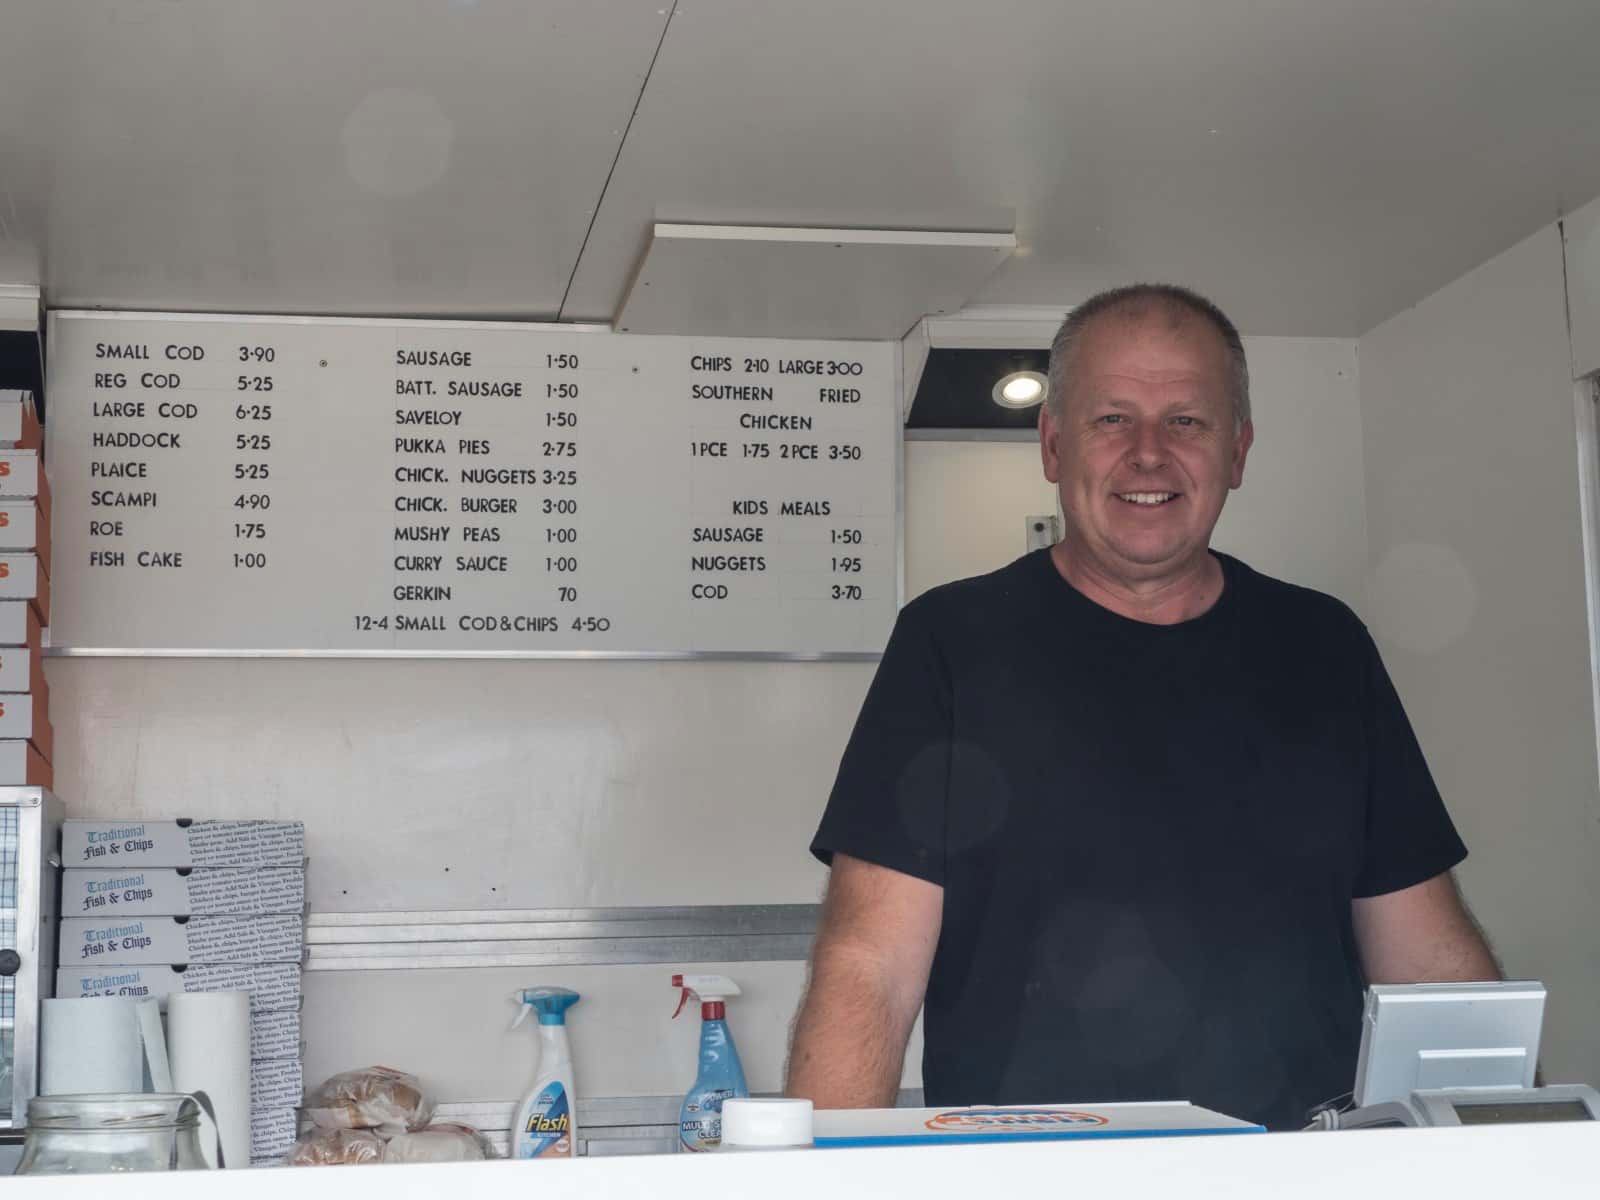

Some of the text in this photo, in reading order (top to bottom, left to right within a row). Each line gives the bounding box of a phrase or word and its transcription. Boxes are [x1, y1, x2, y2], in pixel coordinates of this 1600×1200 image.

[96, 343, 150, 360] SMALL
[165, 345, 205, 361] COD
[396, 350, 472, 367] SAUSAGE
[690, 356, 733, 372] CHIPS
[779, 360, 825, 376] LARGE
[95, 373, 128, 389] REG
[141, 373, 181, 389] COD
[396, 379, 437, 396] BATT.
[448, 381, 523, 398] SAUSAGE
[692, 384, 862, 404] SOUTHERN FRIED
[93, 402, 146, 418] LARGE
[158, 402, 199, 420] COD
[396, 410, 463, 427] SAVELOY
[740, 413, 813, 431] CHICKEN
[93, 432, 181, 449] HADDOCK
[395, 438, 447, 454] PUKKA
[459, 440, 491, 456] PIES
[691, 442, 697, 457] 1
[700, 442, 728, 458] PCE
[780, 444, 790, 459] 2
[792, 444, 819, 460] PCE
[91, 462, 148, 479] PLAICE
[395, 467, 449, 484] CHICK.
[461, 469, 537, 485] NUGGETS
[91, 491, 157, 508] SCAMPI
[395, 496, 448, 513] CHICK.
[461, 497, 518, 514] BURGER
[733, 500, 831, 517] KIDS MEALS
[90, 521, 124, 537] ROE
[394, 526, 451, 543] MUSHY
[464, 527, 501, 543] PEAS
[693, 528, 764, 543] SAUSAGE
[90, 552, 125, 567] FISH
[137, 551, 183, 568] CAKE
[394, 556, 443, 572] CURRY
[456, 556, 508, 572] SAUCE
[692, 556, 767, 572] NUGGETS
[393, 586, 578, 603] GERKIN 70
[692, 584, 729, 600] COD
[355, 616, 389, 631] 12-4
[395, 615, 447, 632] SMALL
[86, 824, 145, 843] Traditional
[83, 839, 153, 860] Fish & Chips
[86, 874, 144, 893] Traditional
[83, 889, 153, 911] Fish & Chips
[84, 922, 144, 941] Traditional
[81, 936, 152, 958] Fish & Chips
[80, 971, 140, 991] Traditional
[527, 1113, 567, 1132] Flash
